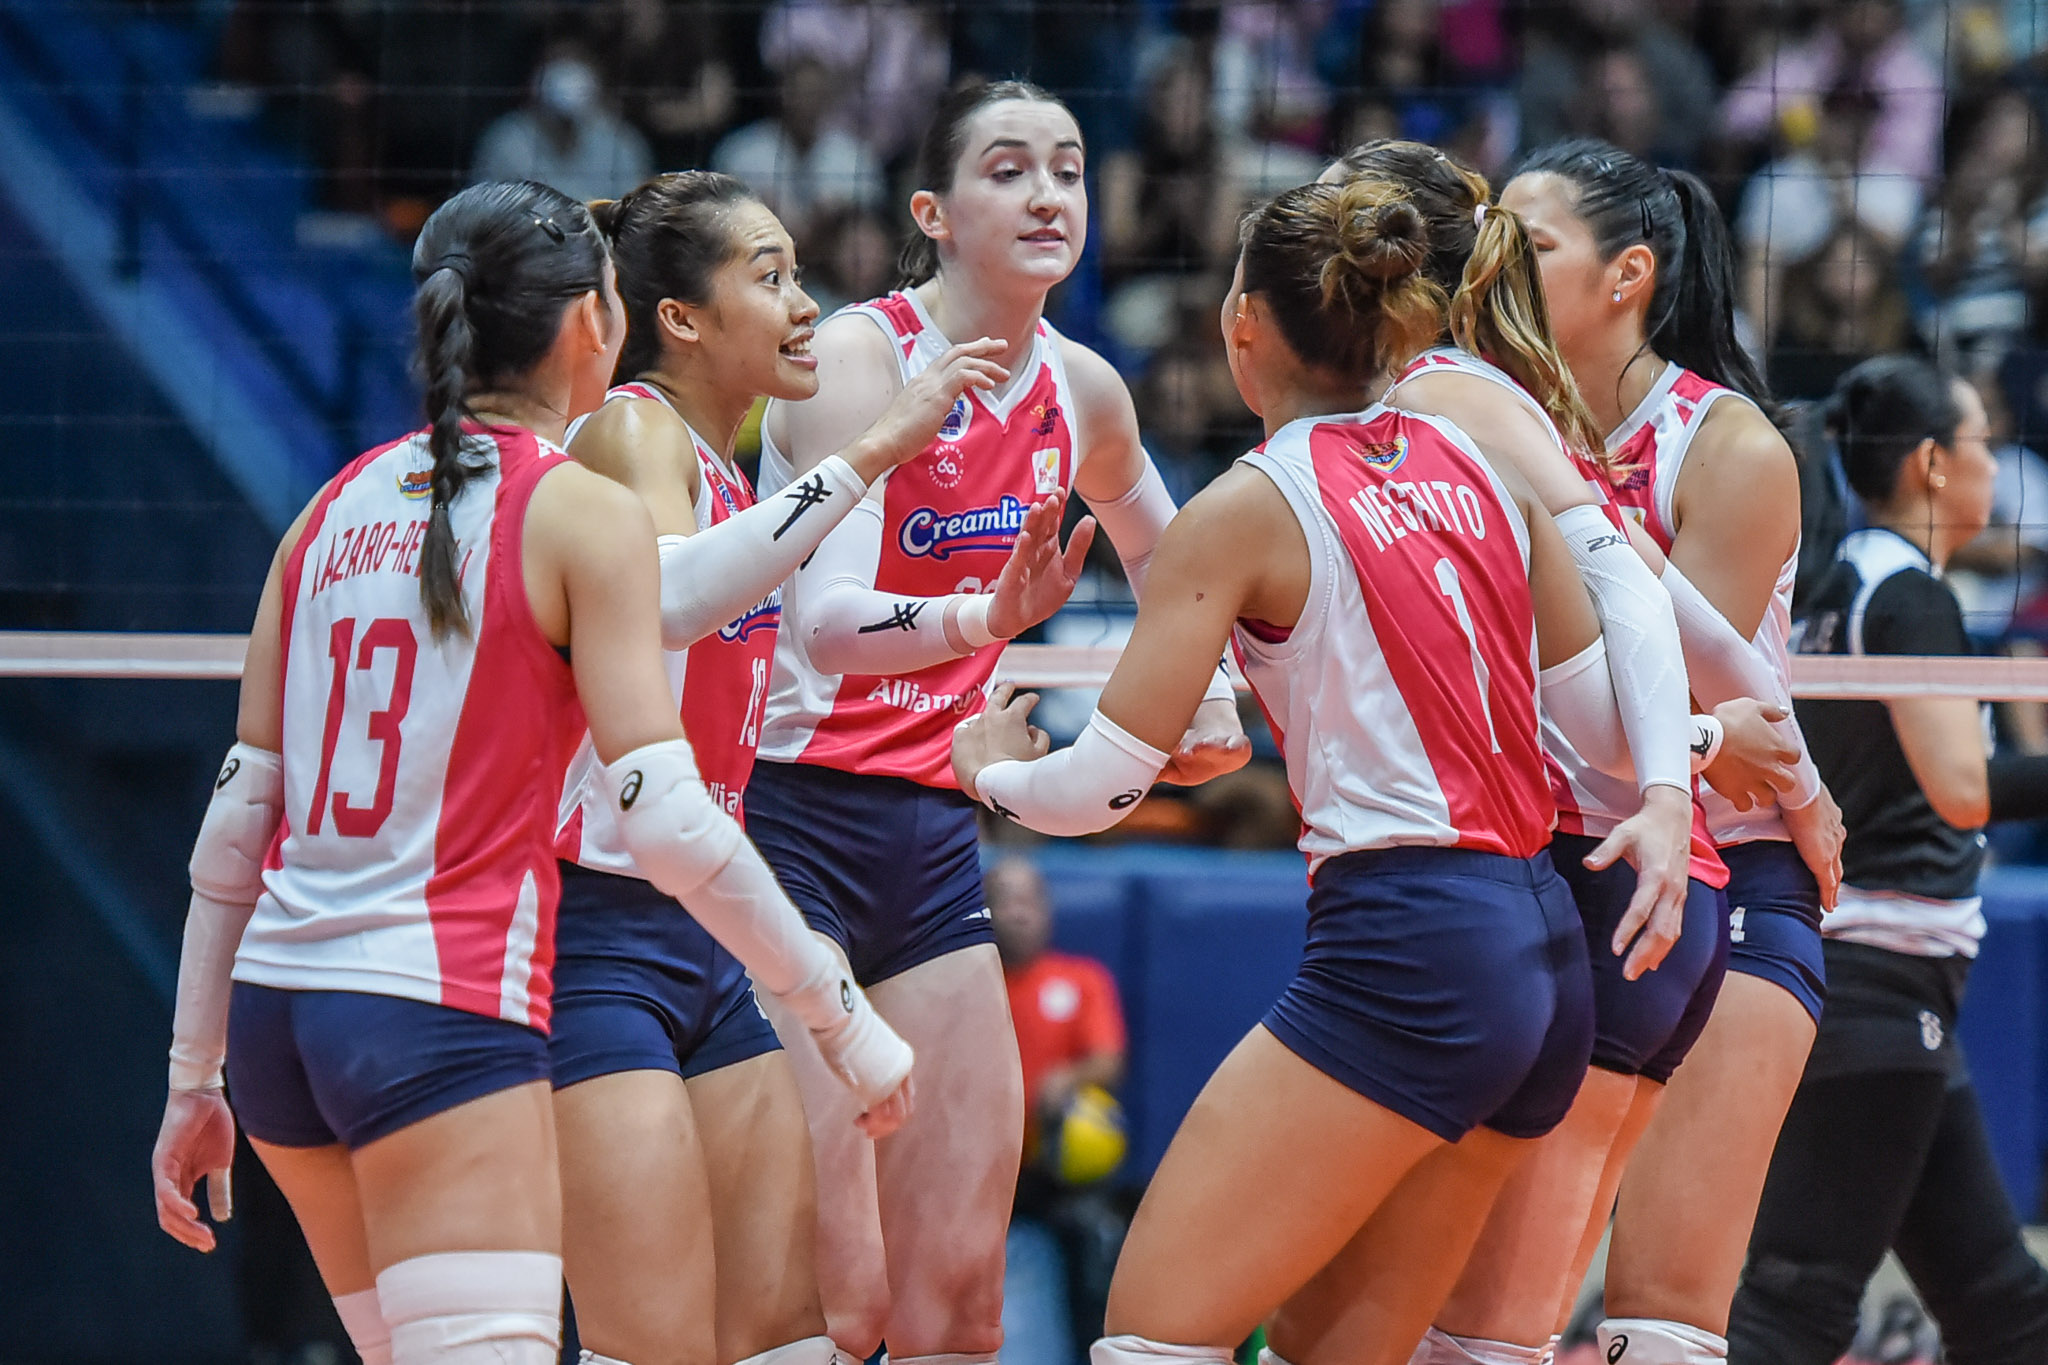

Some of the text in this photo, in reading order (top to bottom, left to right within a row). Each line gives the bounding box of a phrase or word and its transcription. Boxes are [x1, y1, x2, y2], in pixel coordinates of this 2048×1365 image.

[902, 499, 1028, 555] Creamli
[1348, 479, 1486, 553] NEGRITO
[866, 678, 962, 714] Allian
[1433, 557, 1502, 754] 1
[306, 617, 418, 838] 13
[738, 657, 767, 748] 19
